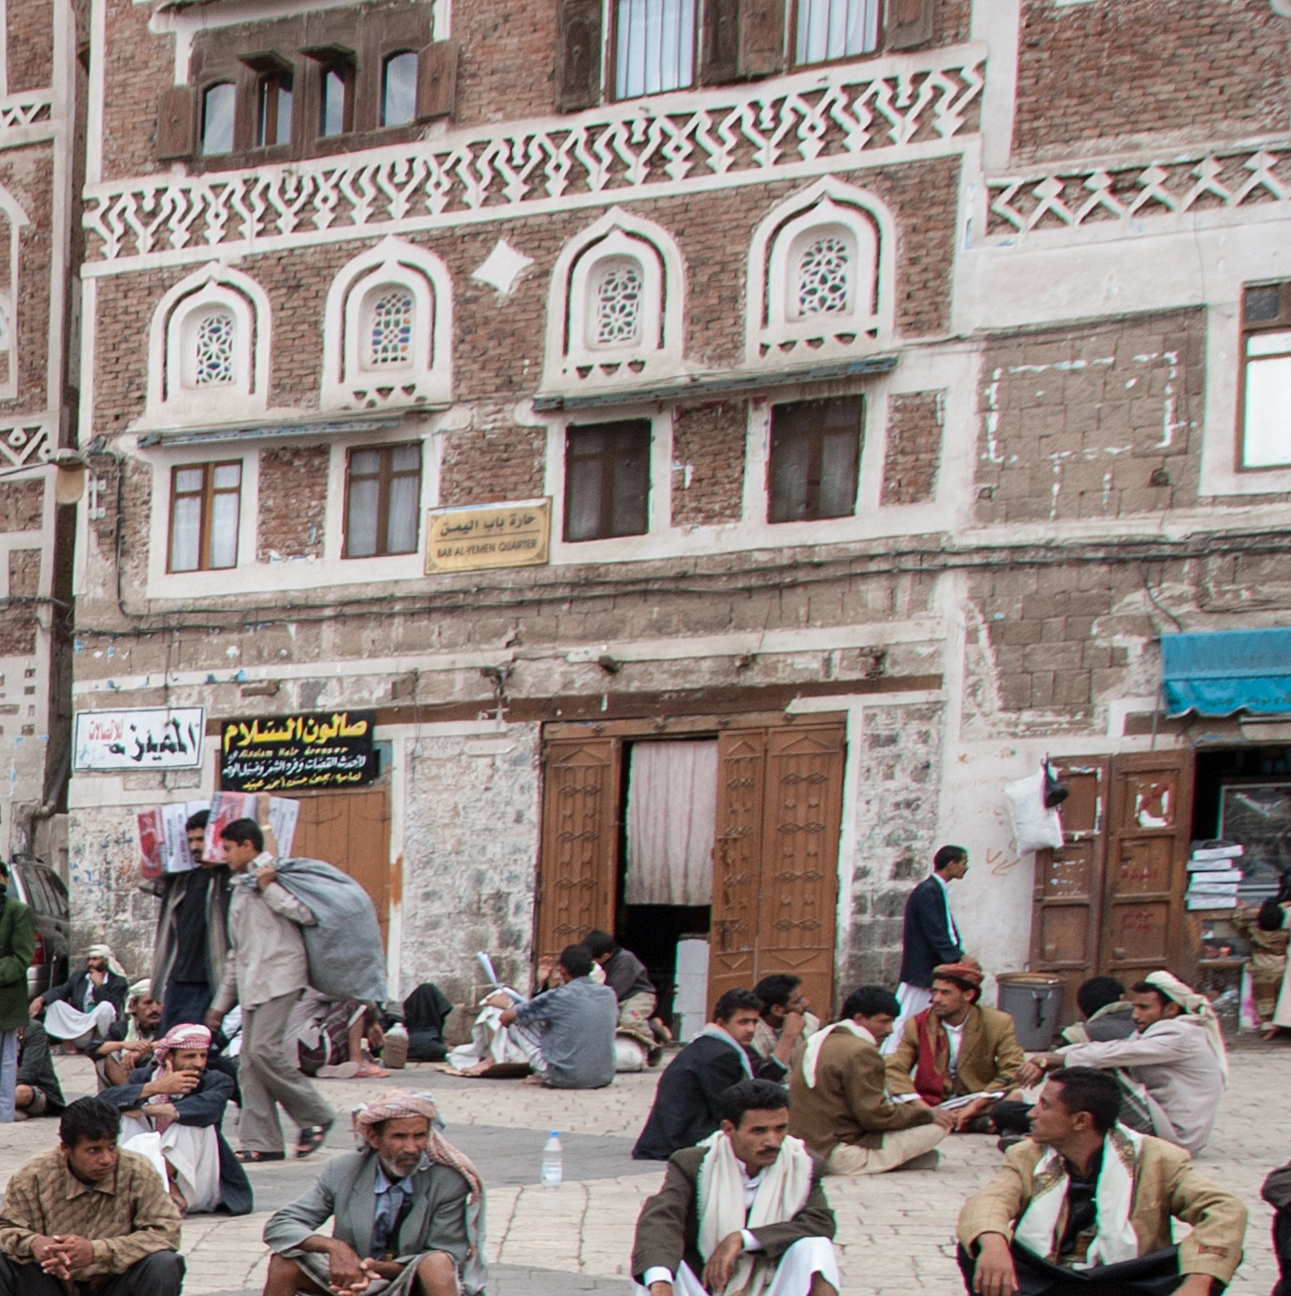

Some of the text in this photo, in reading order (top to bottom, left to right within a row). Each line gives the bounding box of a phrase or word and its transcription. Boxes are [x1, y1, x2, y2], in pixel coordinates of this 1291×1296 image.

[440, 513, 536, 537] حارة باب اليمن
[437, 547, 453, 558] BAB
[498, 539, 537, 552] QUARTER
[224, 712, 368, 756] صالون السلام
